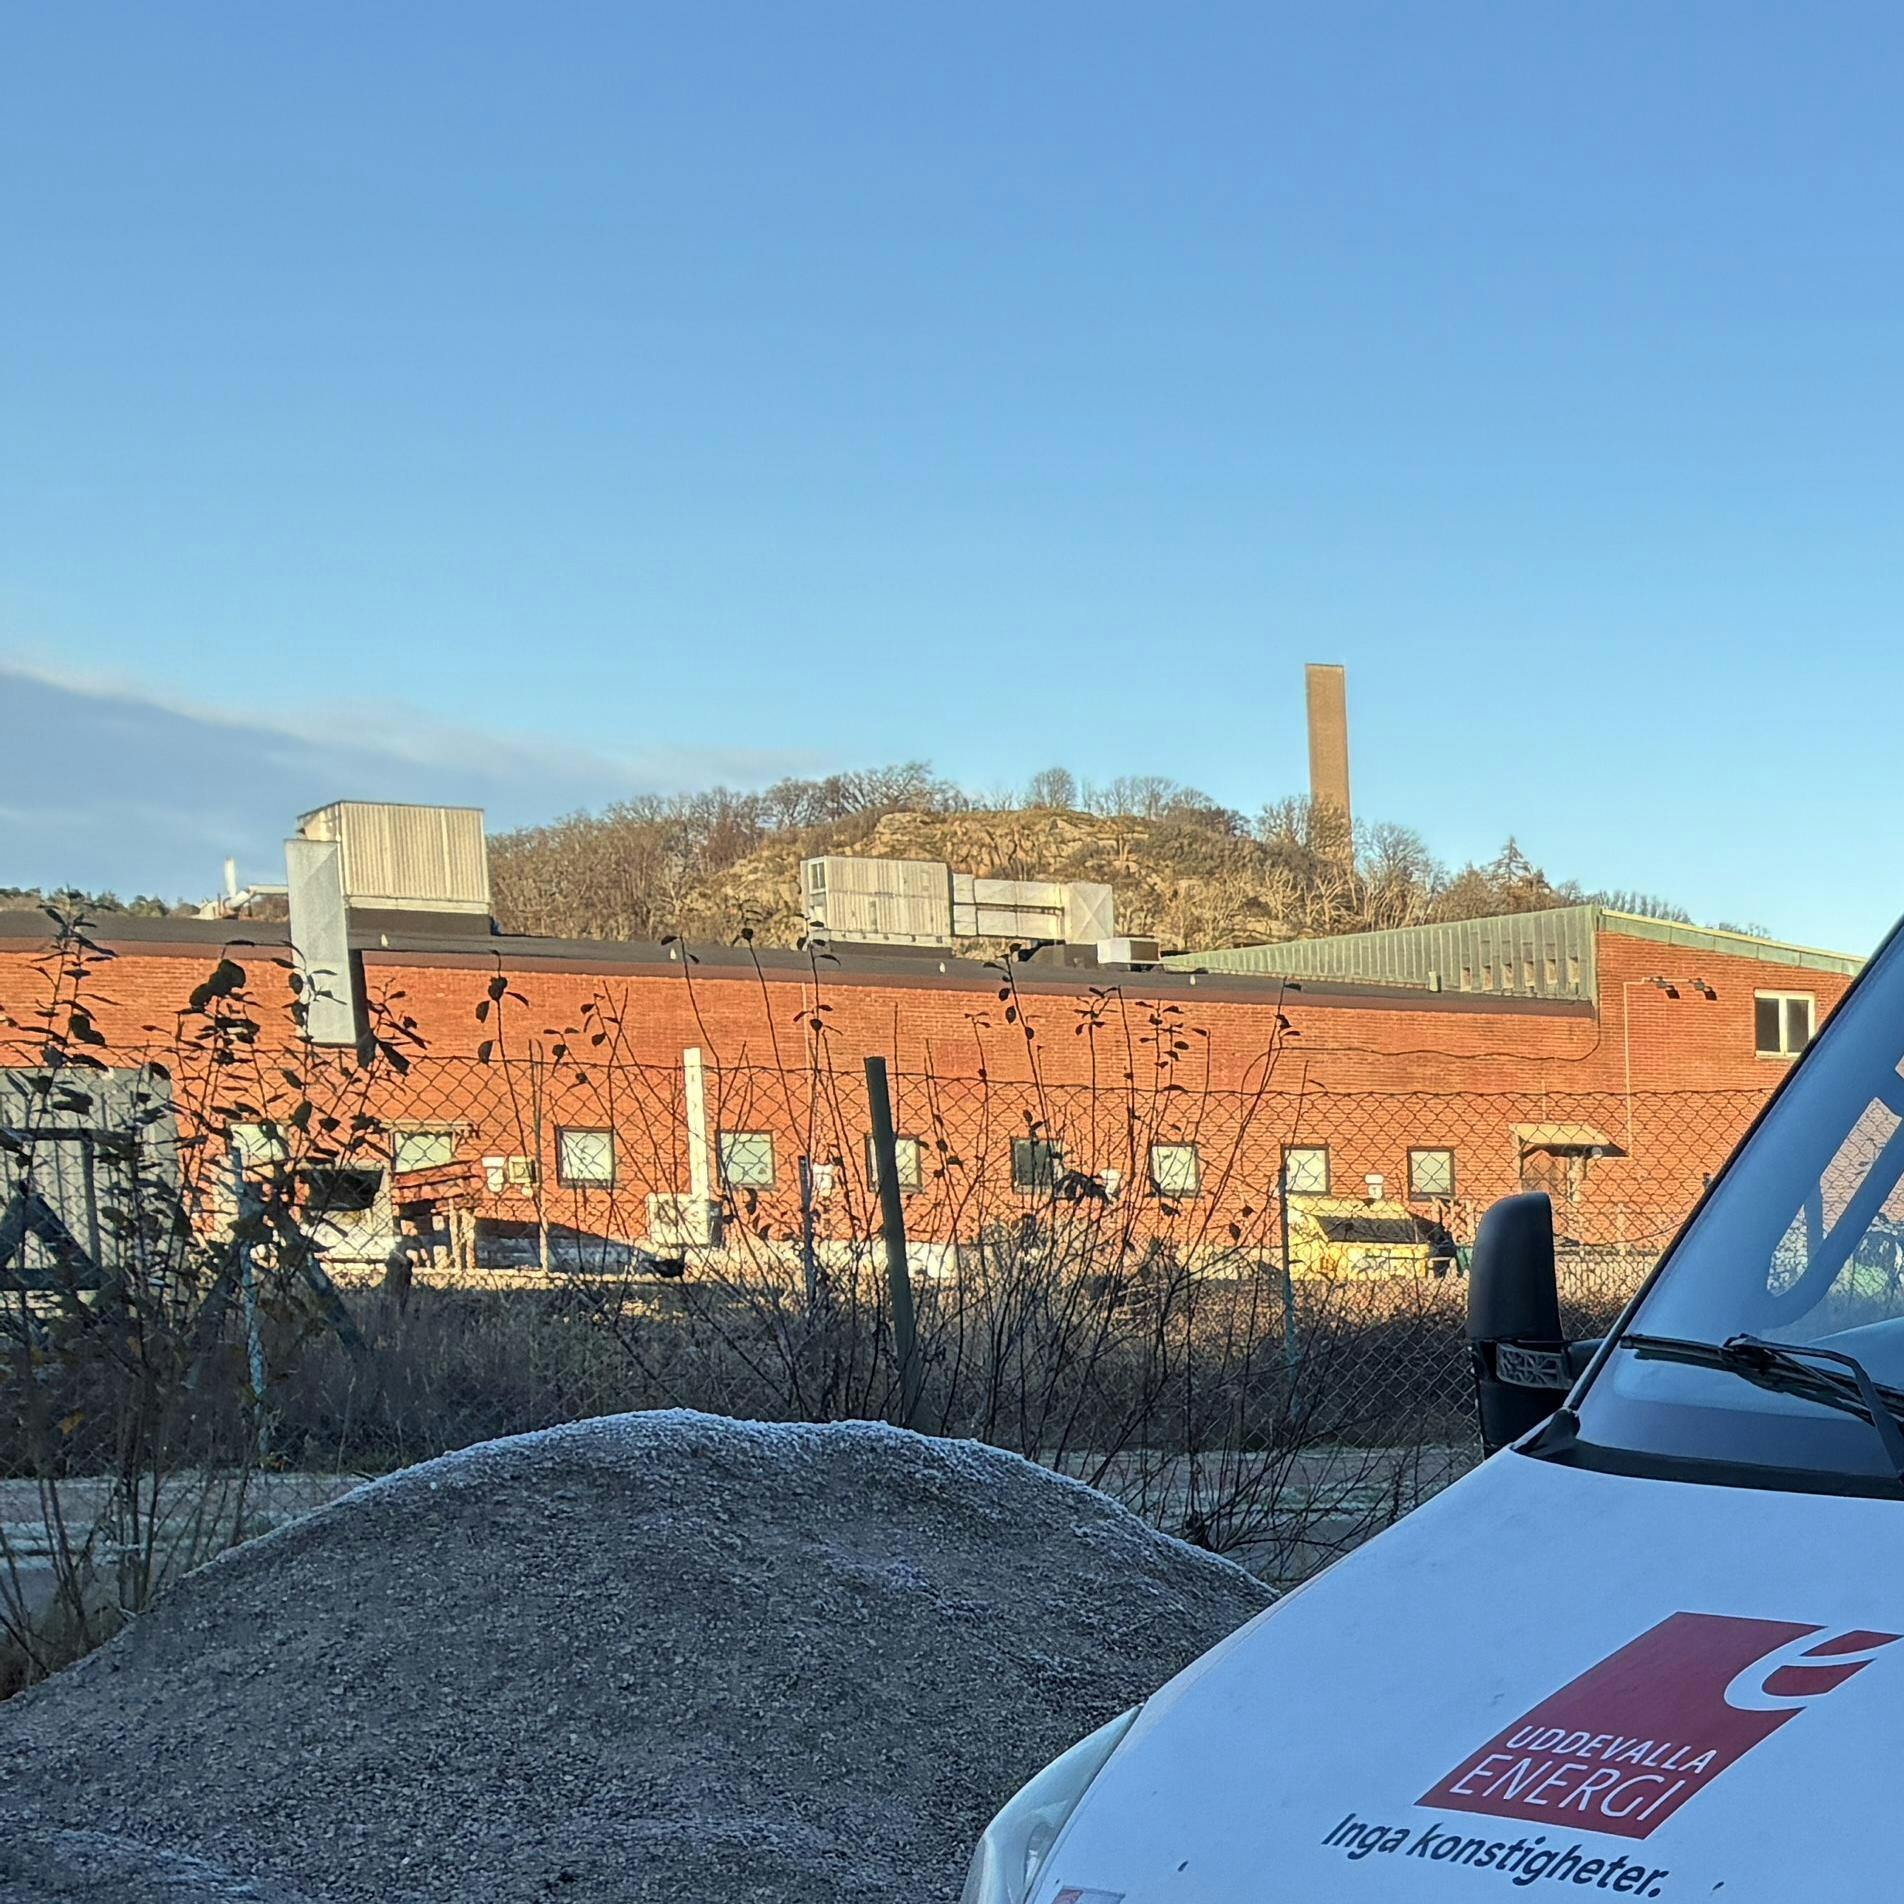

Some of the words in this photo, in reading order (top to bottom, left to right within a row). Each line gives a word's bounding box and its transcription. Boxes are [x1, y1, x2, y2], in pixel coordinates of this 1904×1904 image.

[1505, 1724, 1718, 1775] UDDEVALLA
[1449, 1753, 1687, 1821] ENERGI
[1322, 1812, 1408, 1861] Inga
[1406, 1823, 1669, 1898] konstigheter.
